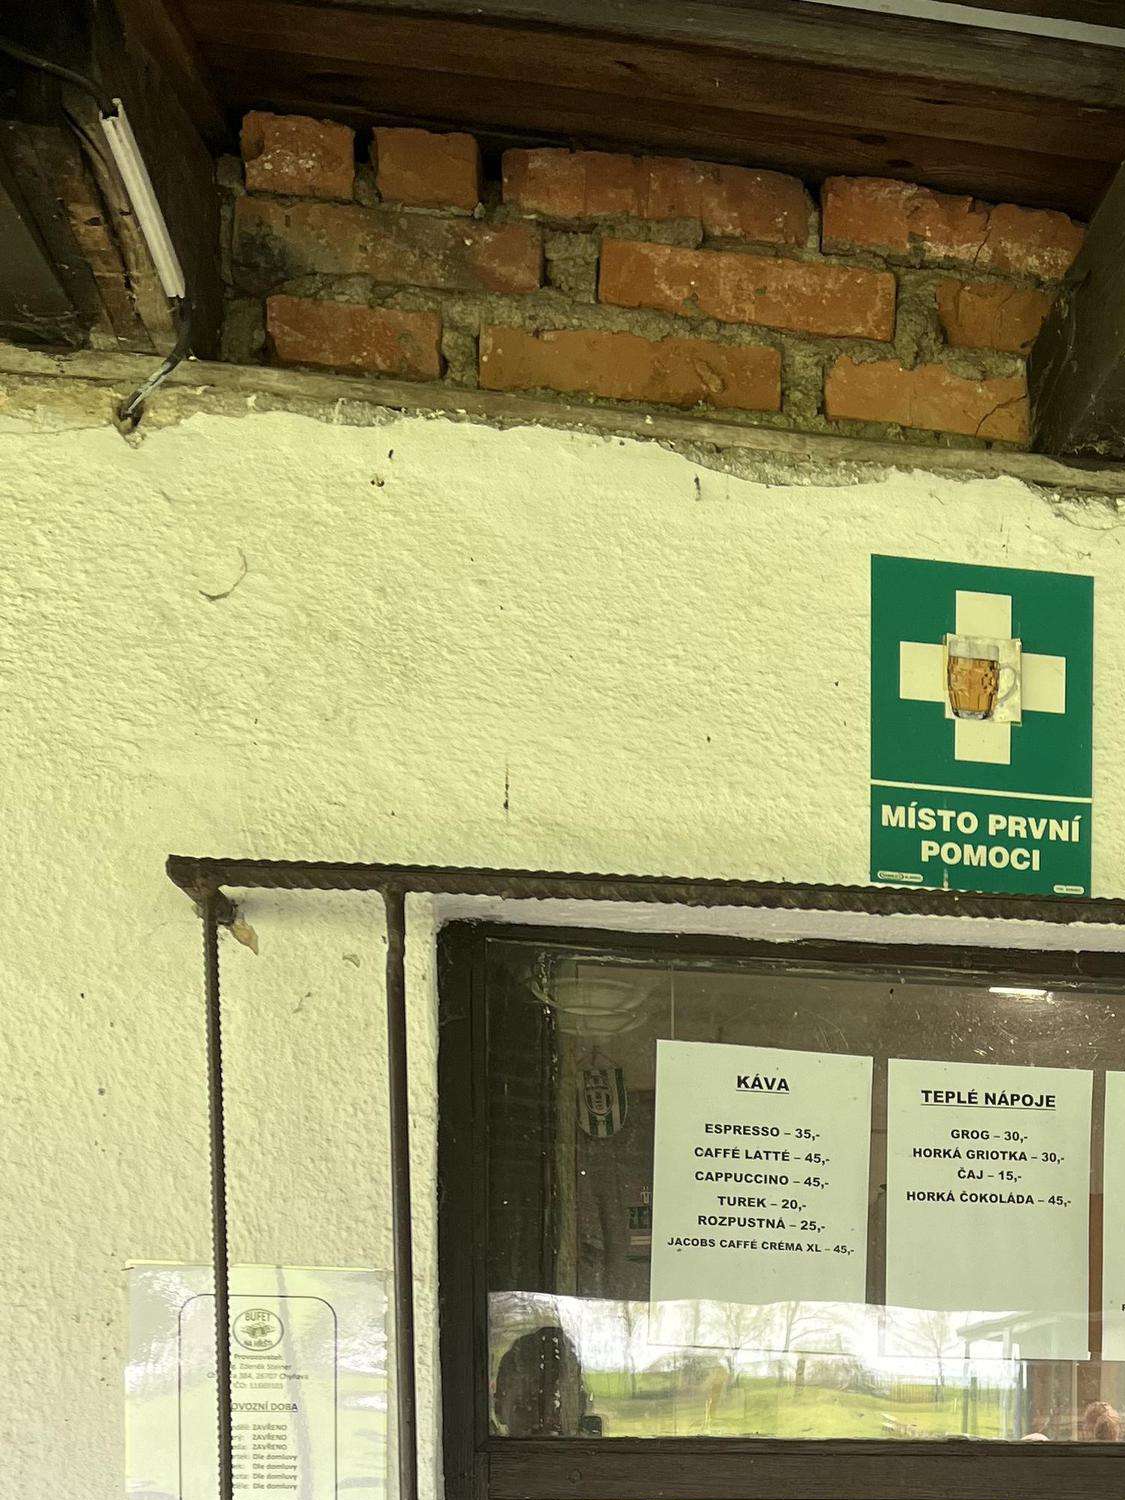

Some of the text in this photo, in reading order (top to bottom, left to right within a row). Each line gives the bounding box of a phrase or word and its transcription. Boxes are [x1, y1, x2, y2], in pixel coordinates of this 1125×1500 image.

[881, 802, 1081, 842] MÍSTO PRVNÍ
[921, 840, 1040, 871] POMOCI
[737, 1073, 790, 1091] KÁVA
[921, 1089, 1056, 1108] TEPLÉ NÁPOJE
[705, 1123, 820, 1141] ESPRESSO 35,-
[951, 1130, 1028, 1143] GROG 30,-
[694, 1146, 830, 1165] CAFFÉ LATTÉ 45,-
[913, 1147, 1064, 1164] HORKÁ GRIOTKA 30,-
[695, 1171, 829, 1189] CAPPUCCINO 45,-
[958, 1167, 1022, 1182] ČAJ 15,-
[718, 1196, 806, 1211] TUREK 20,-
[907, 1190, 1071, 1207] HORKÁ ČOKOLÁDA 45,-
[698, 1215, 825, 1233] ROZPUSTNÁ 25,-
[667, 1238, 854, 1255] JACOBS CAFFÉ CRÉMA XL 45,-
[245, 1312, 270, 1321] BUFET
[232, 1401, 268, 1410] OVOZNÍ
